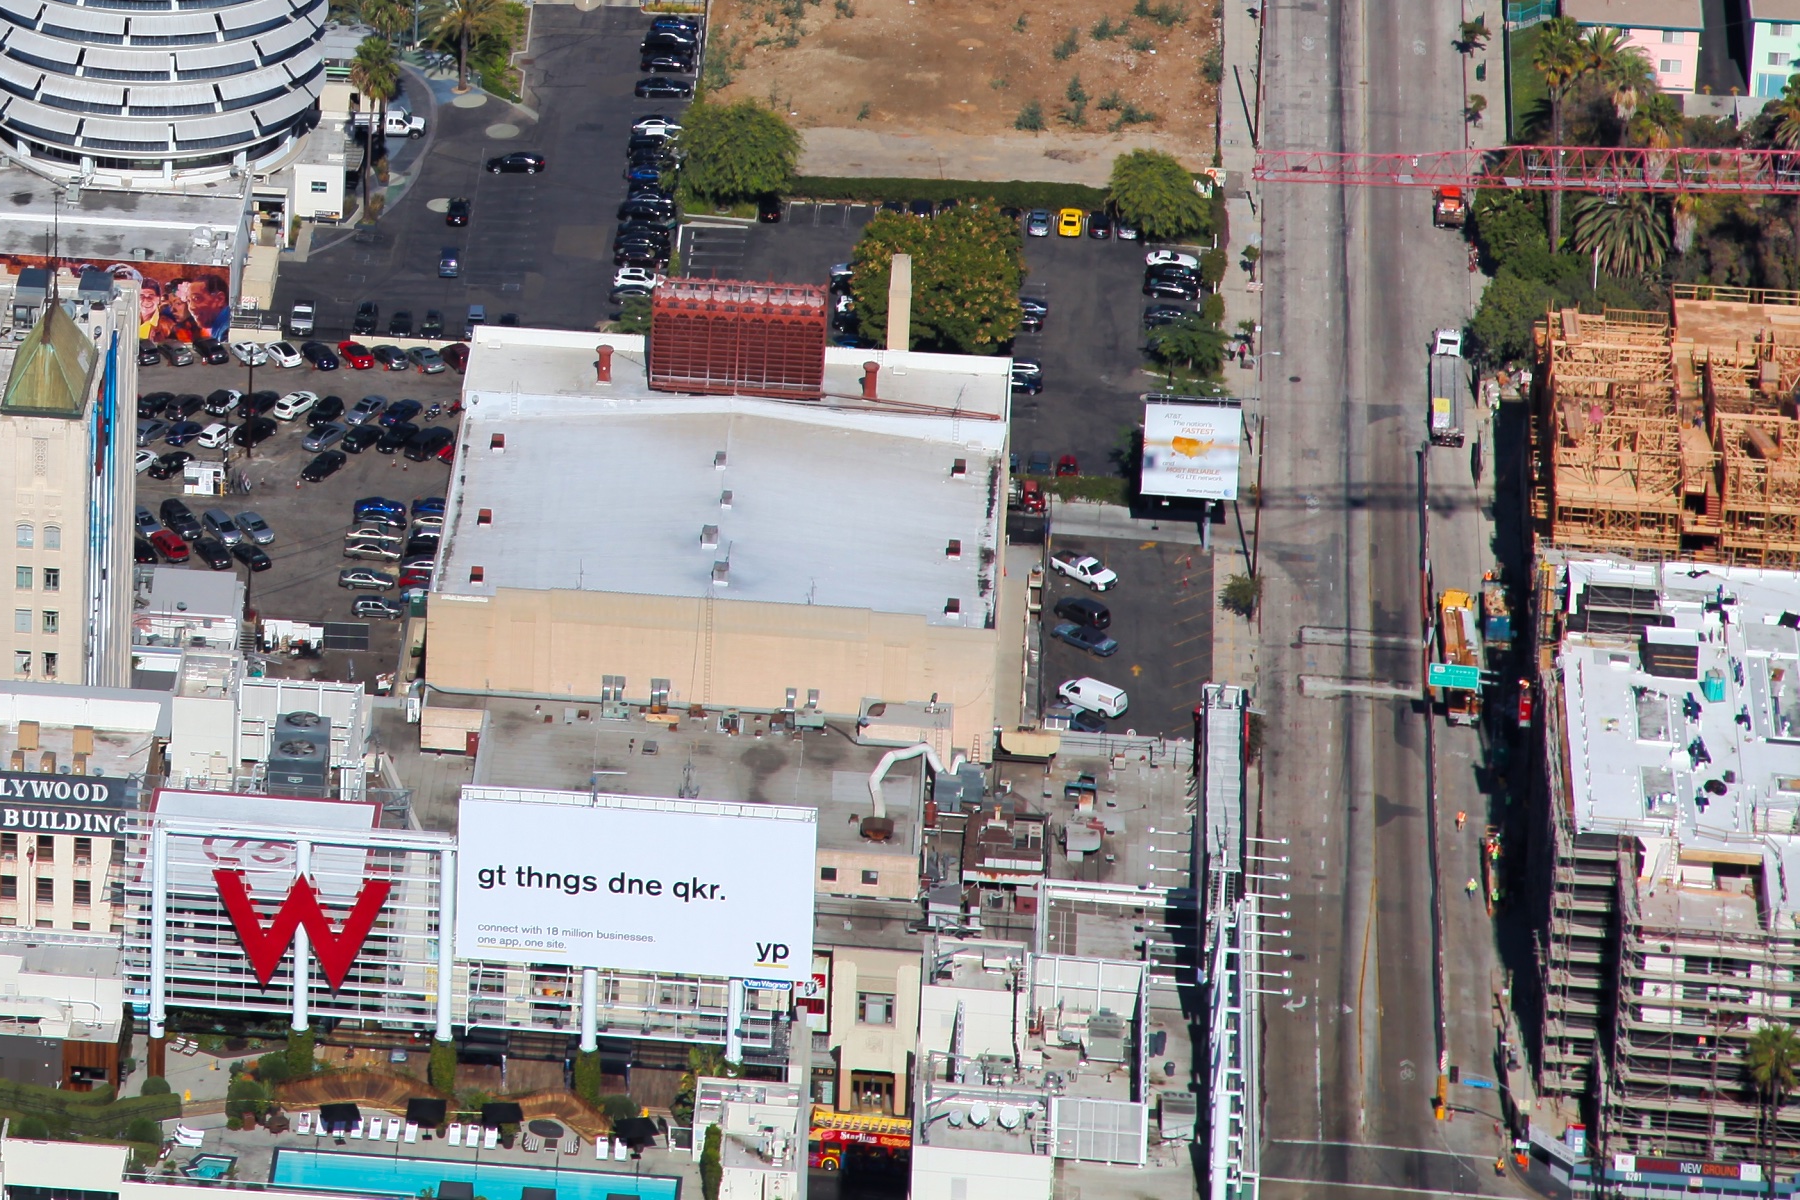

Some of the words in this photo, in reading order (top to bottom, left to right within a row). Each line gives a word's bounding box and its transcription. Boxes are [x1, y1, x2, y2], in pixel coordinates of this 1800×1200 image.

[1181, 427, 1215, 435] FASTEST
[3, 808, 129, 833] BUILDING
[477, 865, 506, 890] gt
[515, 866, 598, 895] thngs
[608, 872, 662, 896] dne
[672, 877, 726, 903] qkr.
[211, 869, 393, 992] W
[477, 923, 519, 934] connect
[521, 925, 542, 935] with
[546, 926, 559, 936] 18
[561, 928, 594, 938] million
[596, 930, 657, 943] businesses.
[477, 936, 497, 945] one
[499, 938, 522, 948] app,
[524, 939, 544, 948] one
[546, 939, 567, 949] site.
[756, 941, 790, 963] yp
[840, 1131, 878, 1144] Starline
[1680, 1162, 1702, 1174] NEW
[1702, 1164, 1740, 1176] GROUND
